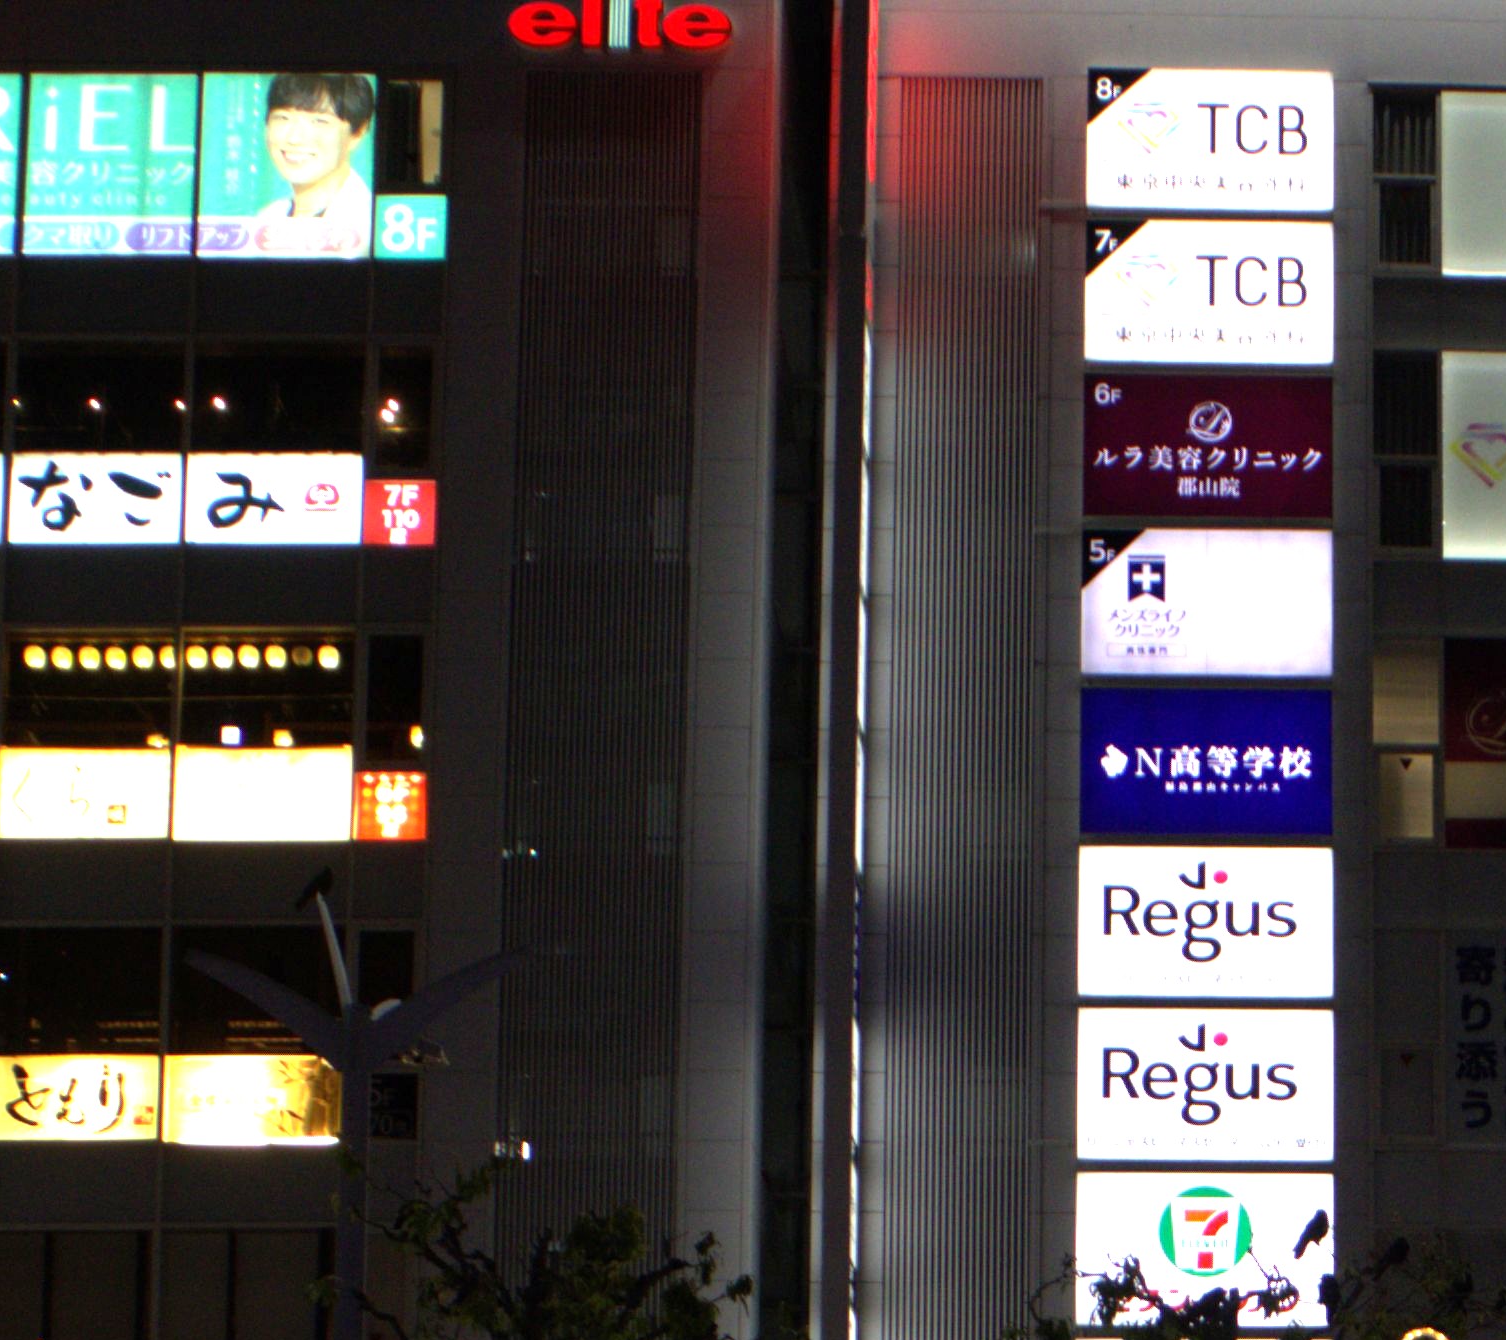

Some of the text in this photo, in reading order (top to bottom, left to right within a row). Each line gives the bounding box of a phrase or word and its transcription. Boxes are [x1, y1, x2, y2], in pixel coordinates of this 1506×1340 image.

[507, 0, 732, 48] elite
[1095, 76, 1122, 101] 8F
[1197, 103, 1308, 155] TCB
[140, 222, 248, 249] リフトアップ
[381, 203, 437, 253] 8F
[1093, 229, 1119, 253] 7F
[1195, 255, 1308, 307] TCB
[1093, 382, 1123, 405] 6F
[1094, 445, 1324, 473] ルラ美容クリニック
[18, 460, 284, 532] なごみ
[383, 483, 420, 507] 7F
[1176, 475, 1242, 498] 郡山院
[1089, 540, 1116, 563] 5F
[1134, 744, 1314, 779] N高等学校
[1102, 884, 1298, 963] Regus
[1455, 946, 1497, 1129] 寄り添う
[1101, 1046, 1298, 1127] Regus
